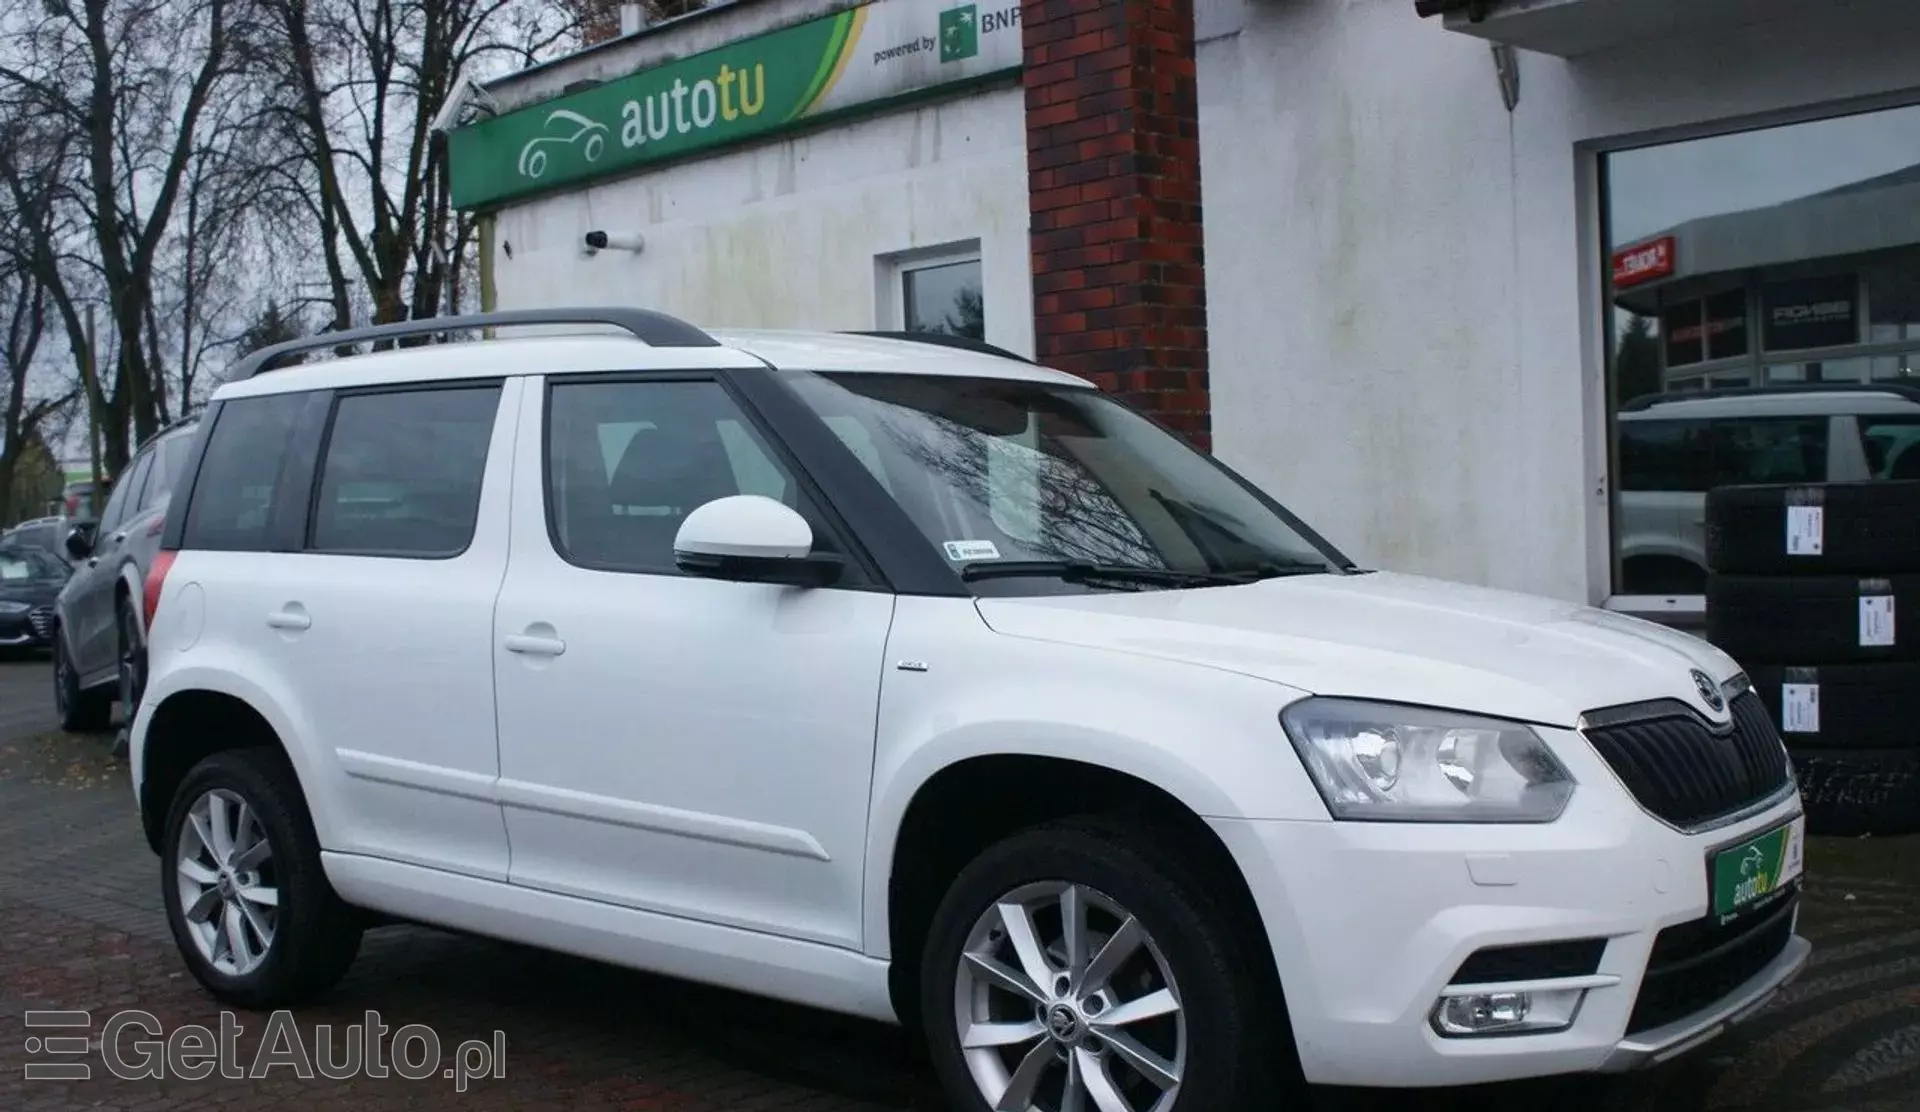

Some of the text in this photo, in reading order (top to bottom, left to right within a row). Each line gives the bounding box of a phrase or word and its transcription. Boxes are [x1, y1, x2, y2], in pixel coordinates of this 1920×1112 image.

[873, 6, 1022, 66] powered by BNP
[621, 63, 765, 148] autotu
[1733, 871, 1768, 905] autotu
